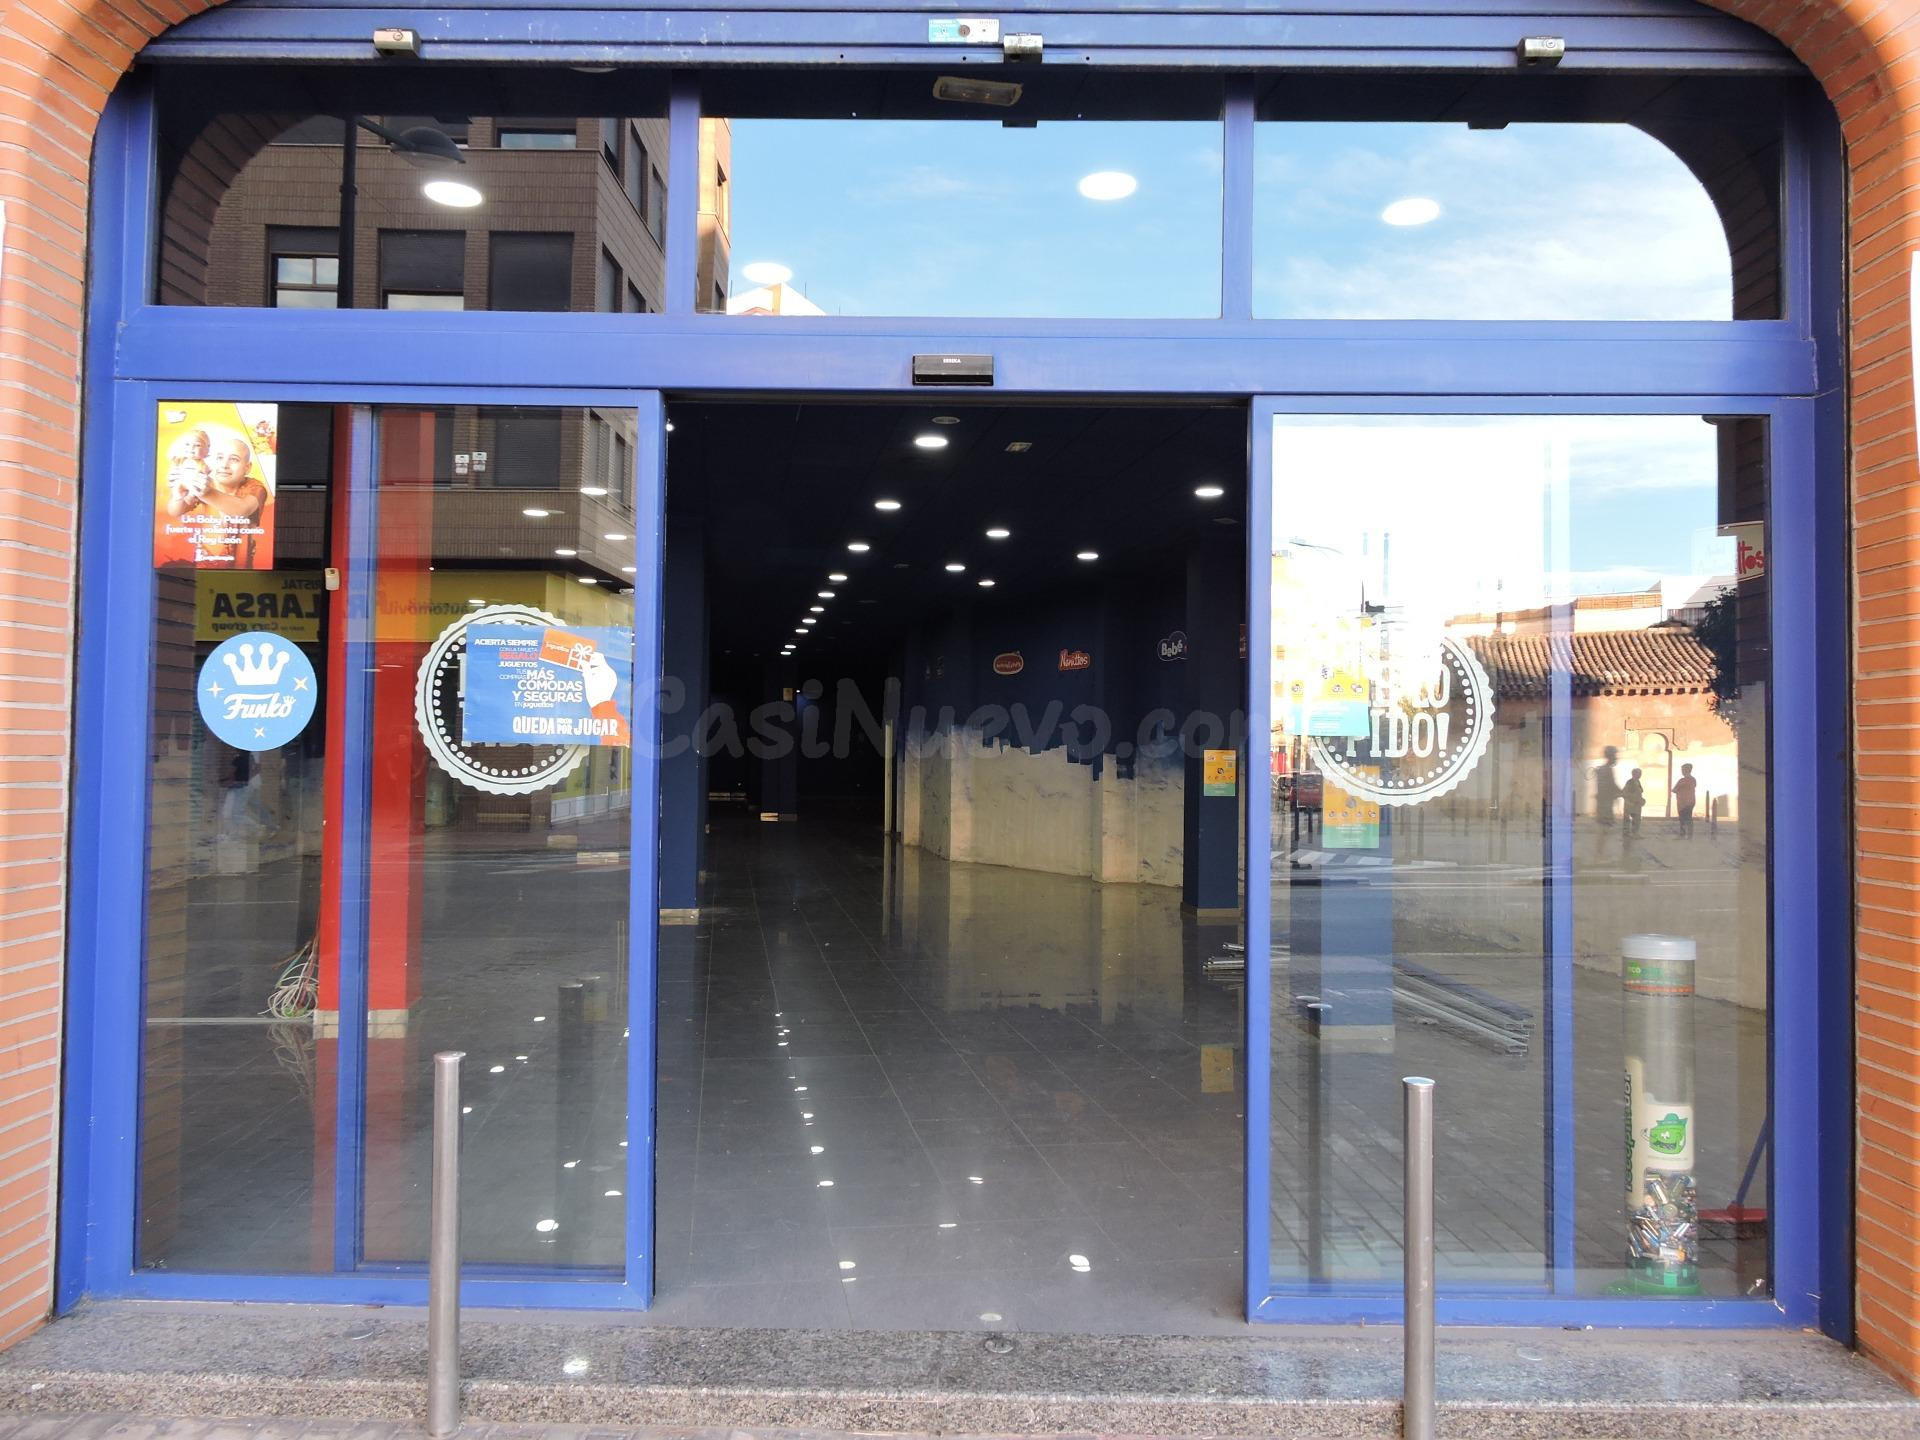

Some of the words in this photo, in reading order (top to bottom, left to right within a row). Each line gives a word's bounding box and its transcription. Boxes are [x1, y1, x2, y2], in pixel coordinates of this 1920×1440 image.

[197, 515, 222, 527] Baby
[223, 515, 250, 524] Pelón
[166, 524, 194, 535] fuerte
[202, 524, 239, 534] valiente
[217, 534, 242, 544] León
[474, 639, 506, 647] ACIERTA
[507, 639, 539, 647] SIEMPRE
[527, 667, 555, 680] MÁS
[512, 691, 522, 702] Y
[523, 691, 583, 703] SEGURAS
[223, 692, 296, 720] Funko
[512, 715, 555, 735] QUEDA
[573, 717, 619, 736] JUGAR
